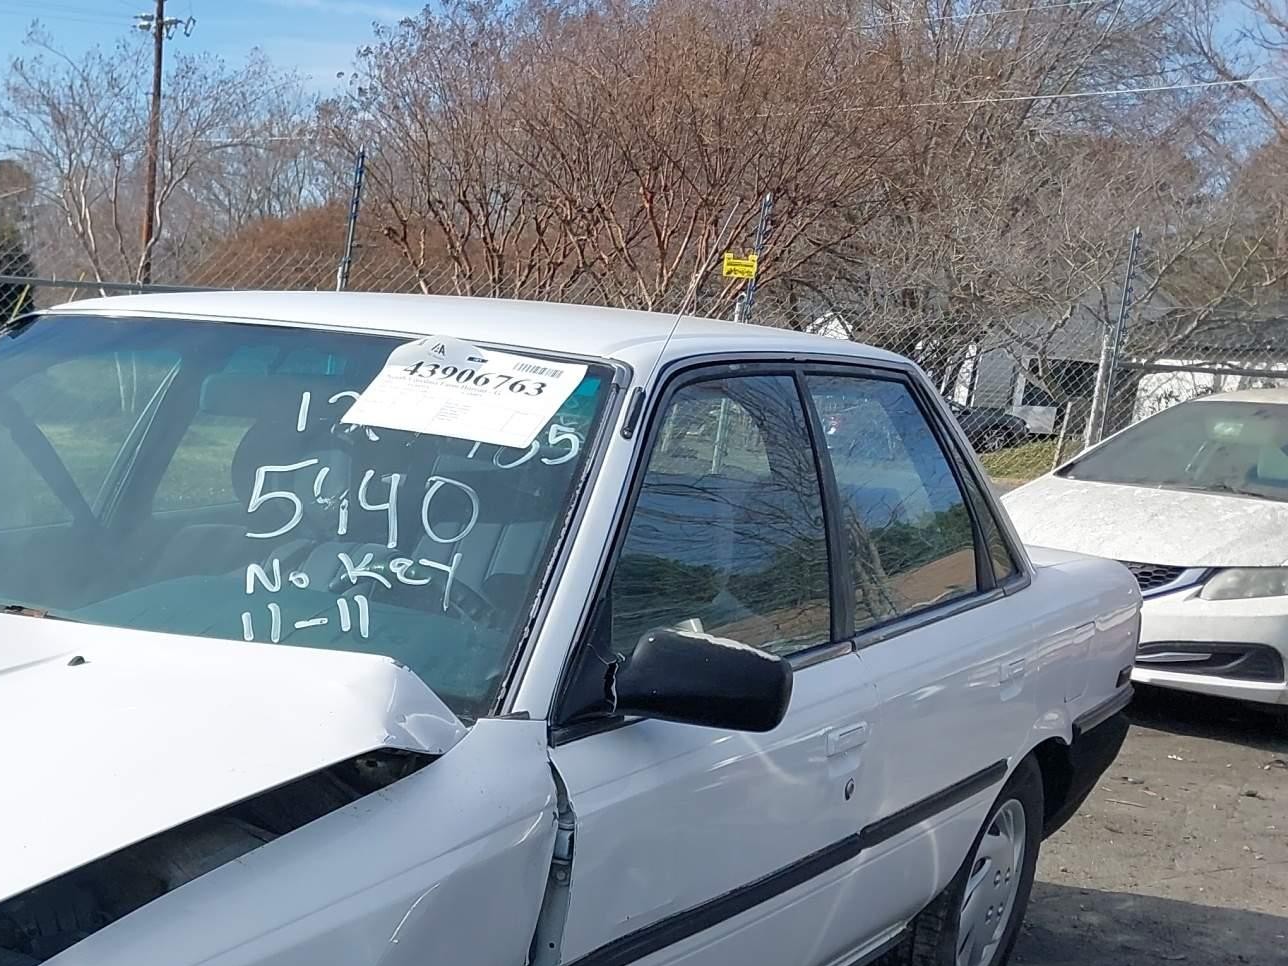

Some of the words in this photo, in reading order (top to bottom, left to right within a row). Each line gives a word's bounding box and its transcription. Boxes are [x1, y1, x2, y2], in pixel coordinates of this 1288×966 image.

[403, 360, 547, 397] 43906763
[246, 458, 480, 549] 5440
[245, 558, 310, 594] No
[241, 594, 369, 643] 11-11
